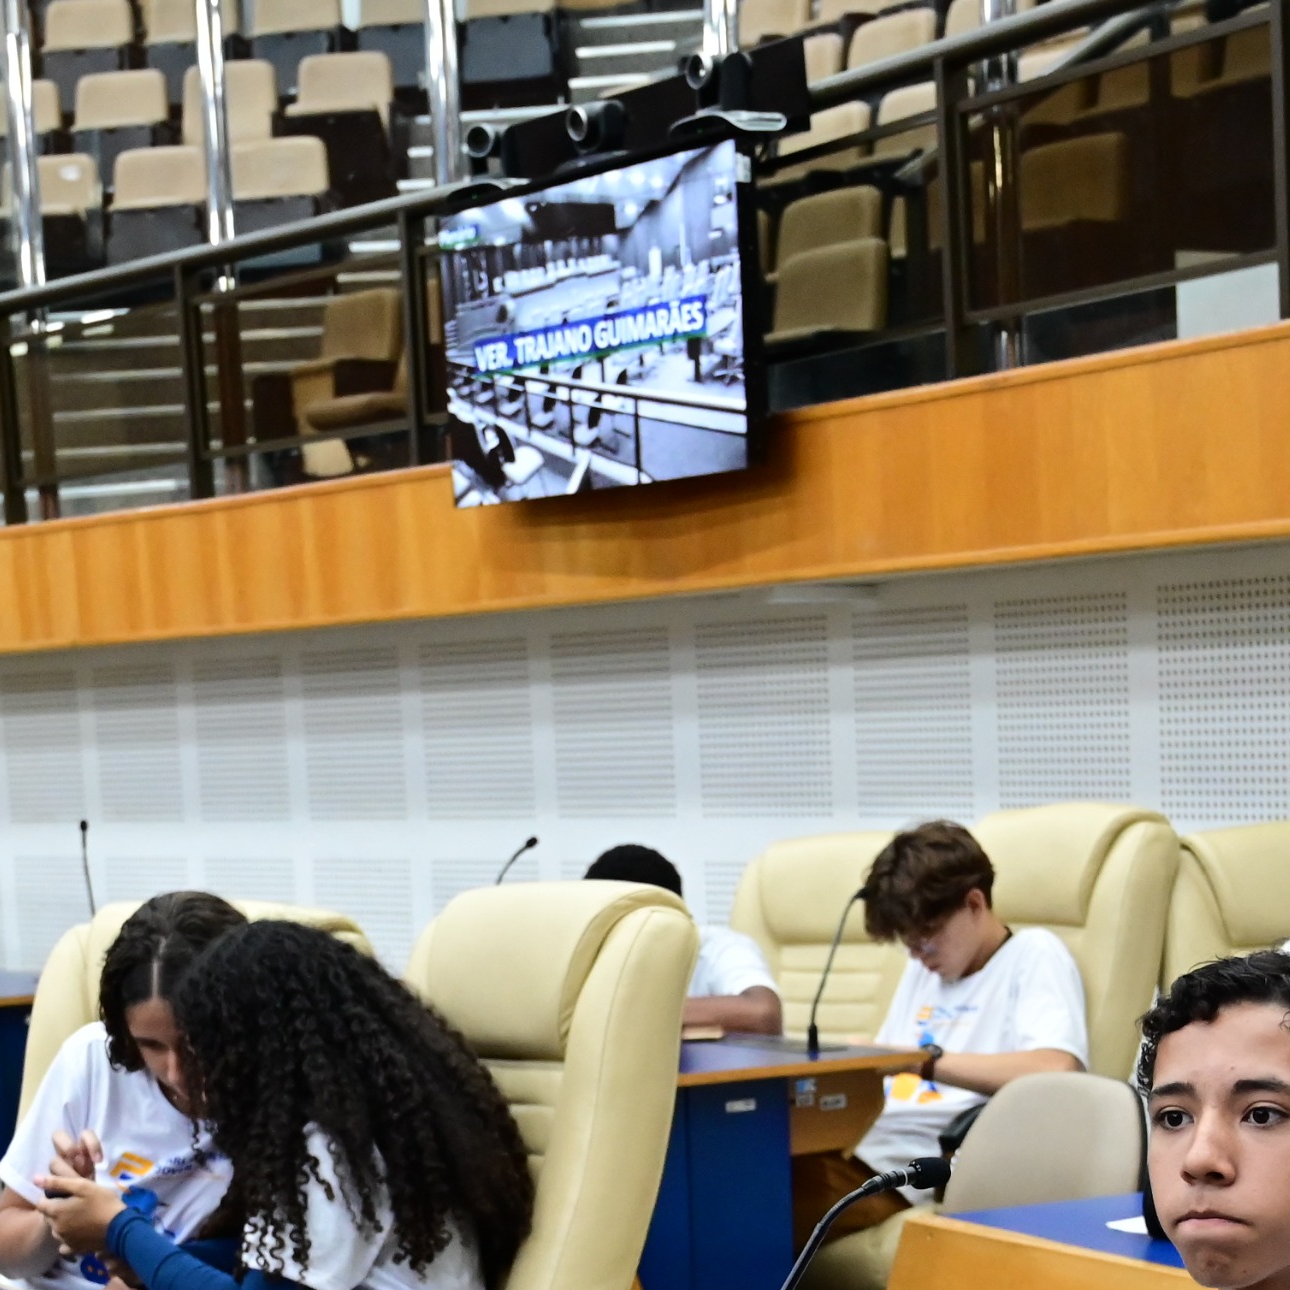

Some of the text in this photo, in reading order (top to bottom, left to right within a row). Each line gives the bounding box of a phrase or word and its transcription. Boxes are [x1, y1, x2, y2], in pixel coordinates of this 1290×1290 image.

[475, 301, 705, 373] VER. TRAJANO GUIMARÃES
